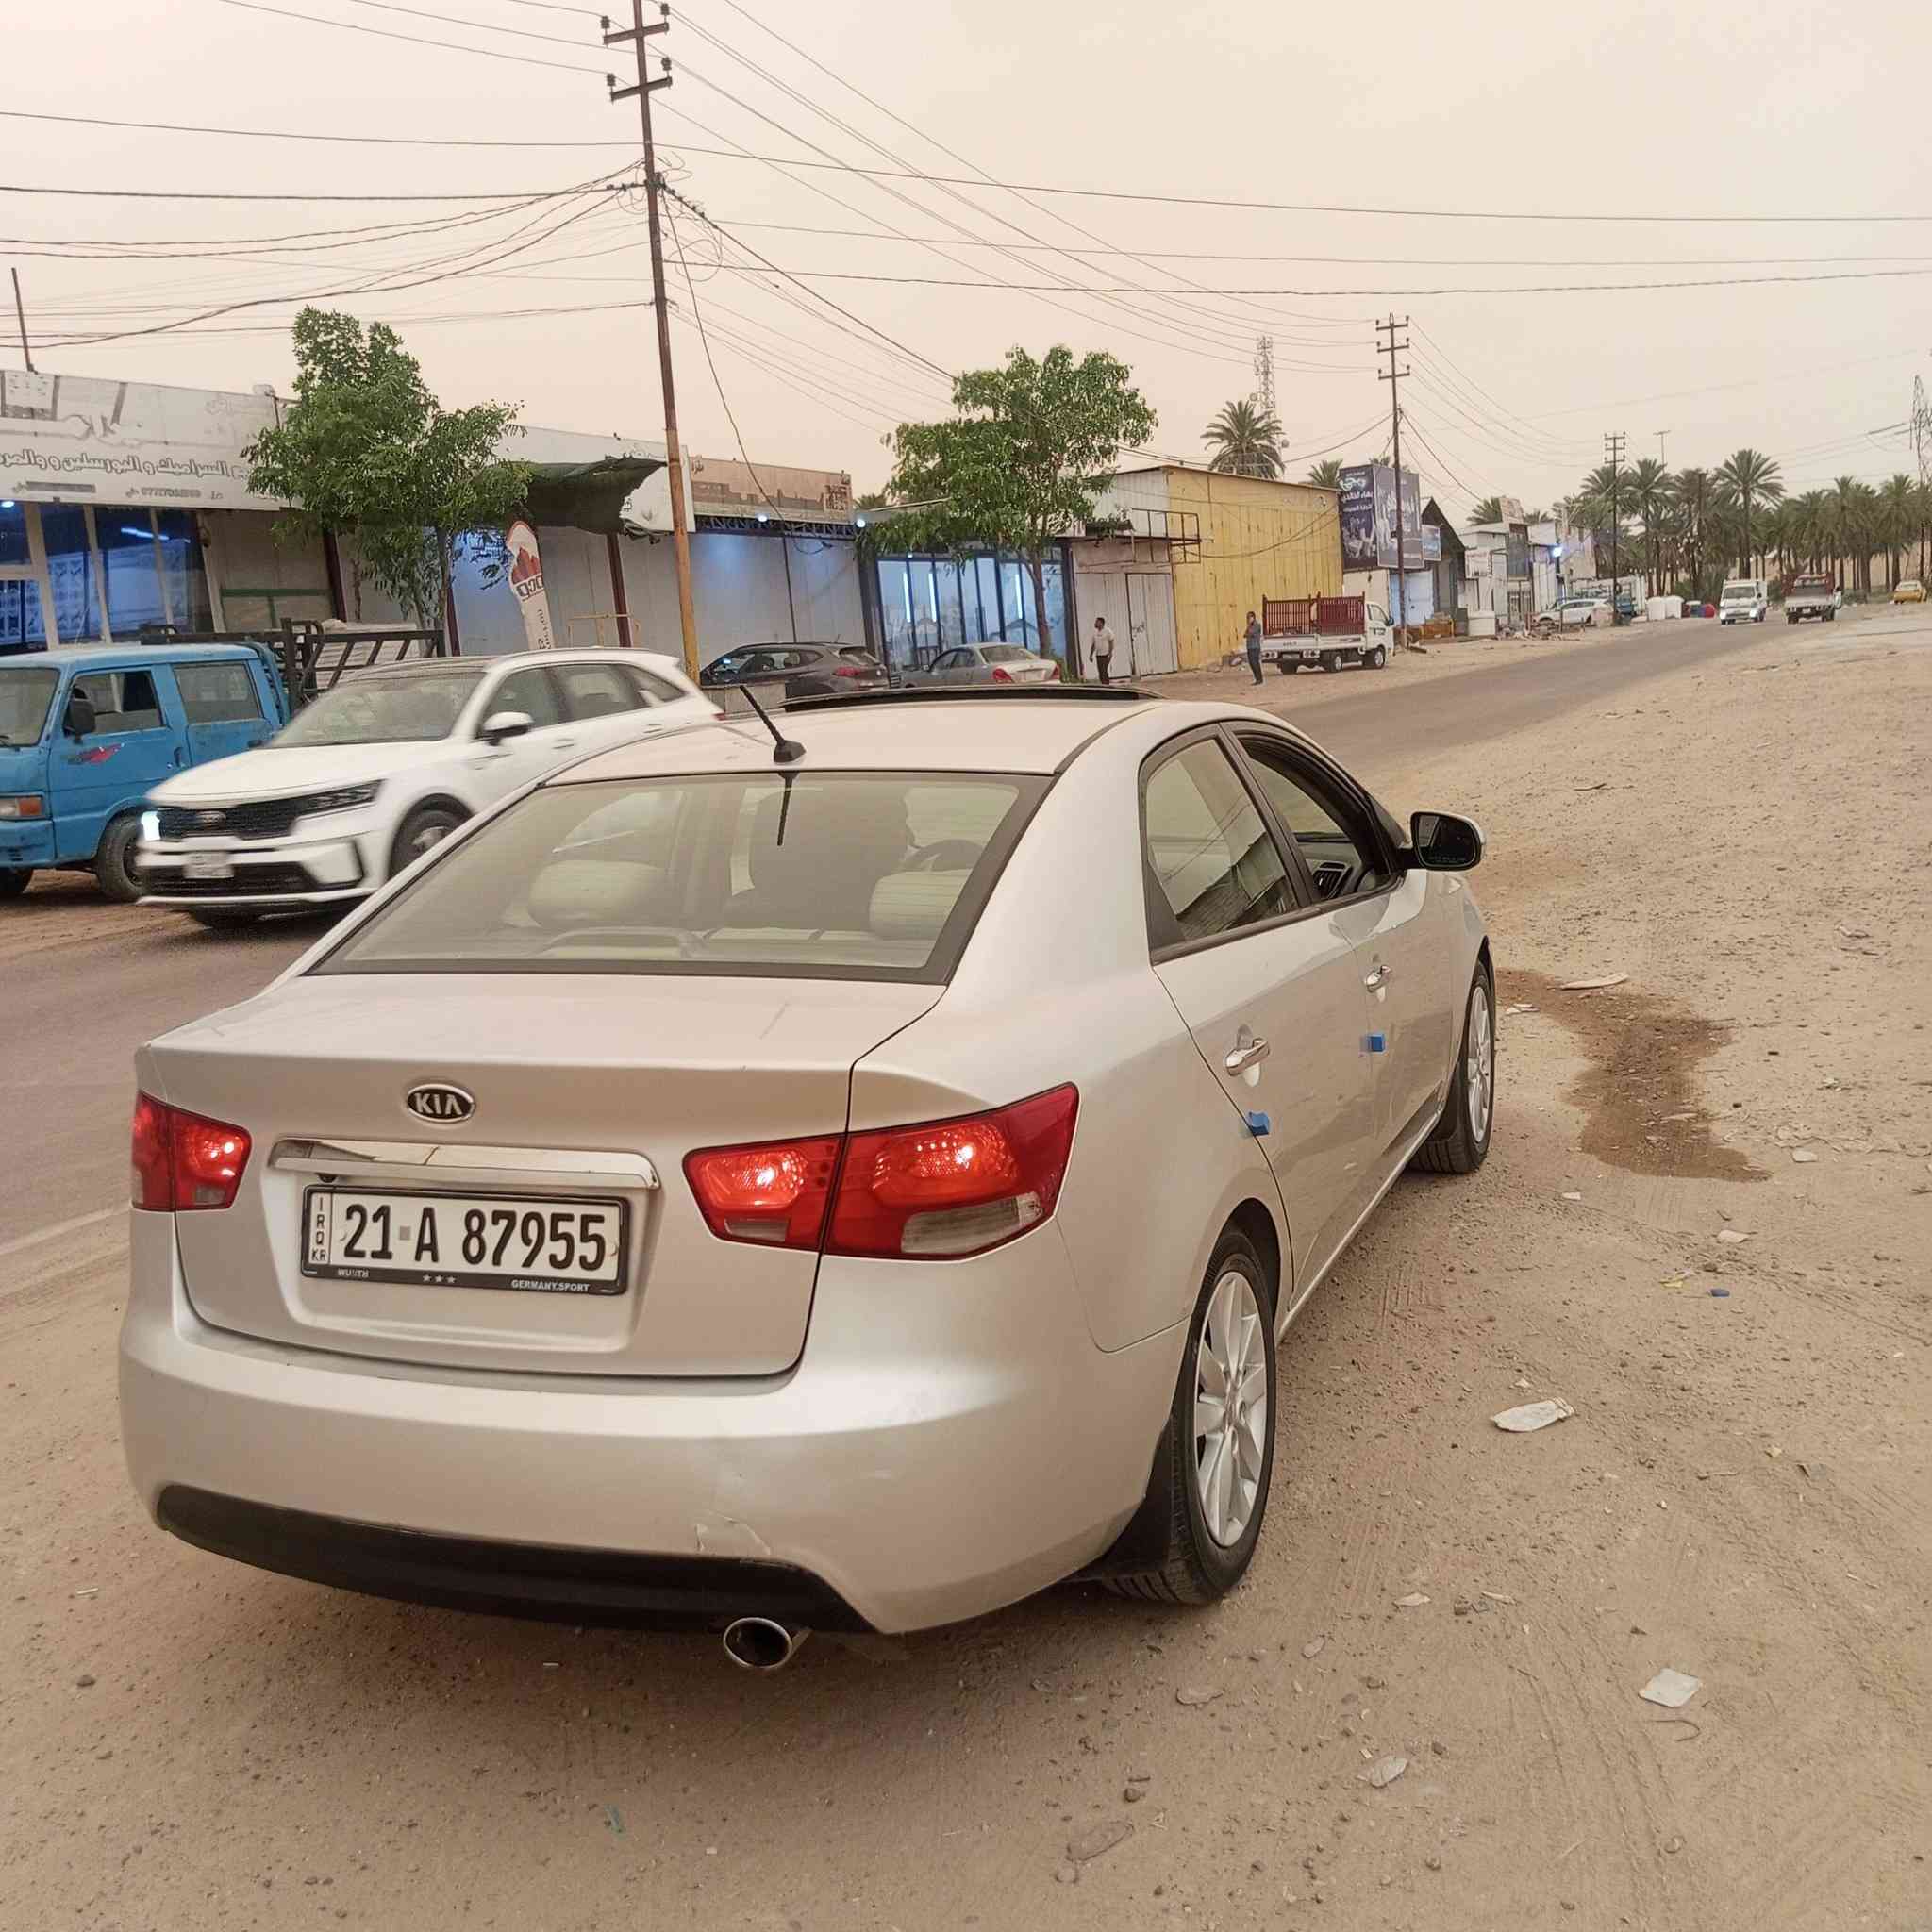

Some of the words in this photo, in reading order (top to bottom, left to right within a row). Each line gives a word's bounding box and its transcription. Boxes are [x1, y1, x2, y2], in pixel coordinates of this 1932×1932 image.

[0, 449, 47, 470] والمر
[413, 1092, 463, 1115] KIA
[343, 1204, 393, 1260] 21
[414, 1207, 439, 1263] A
[461, 1208, 606, 1271] 87955
[311, 1248, 326, 1261] KR
